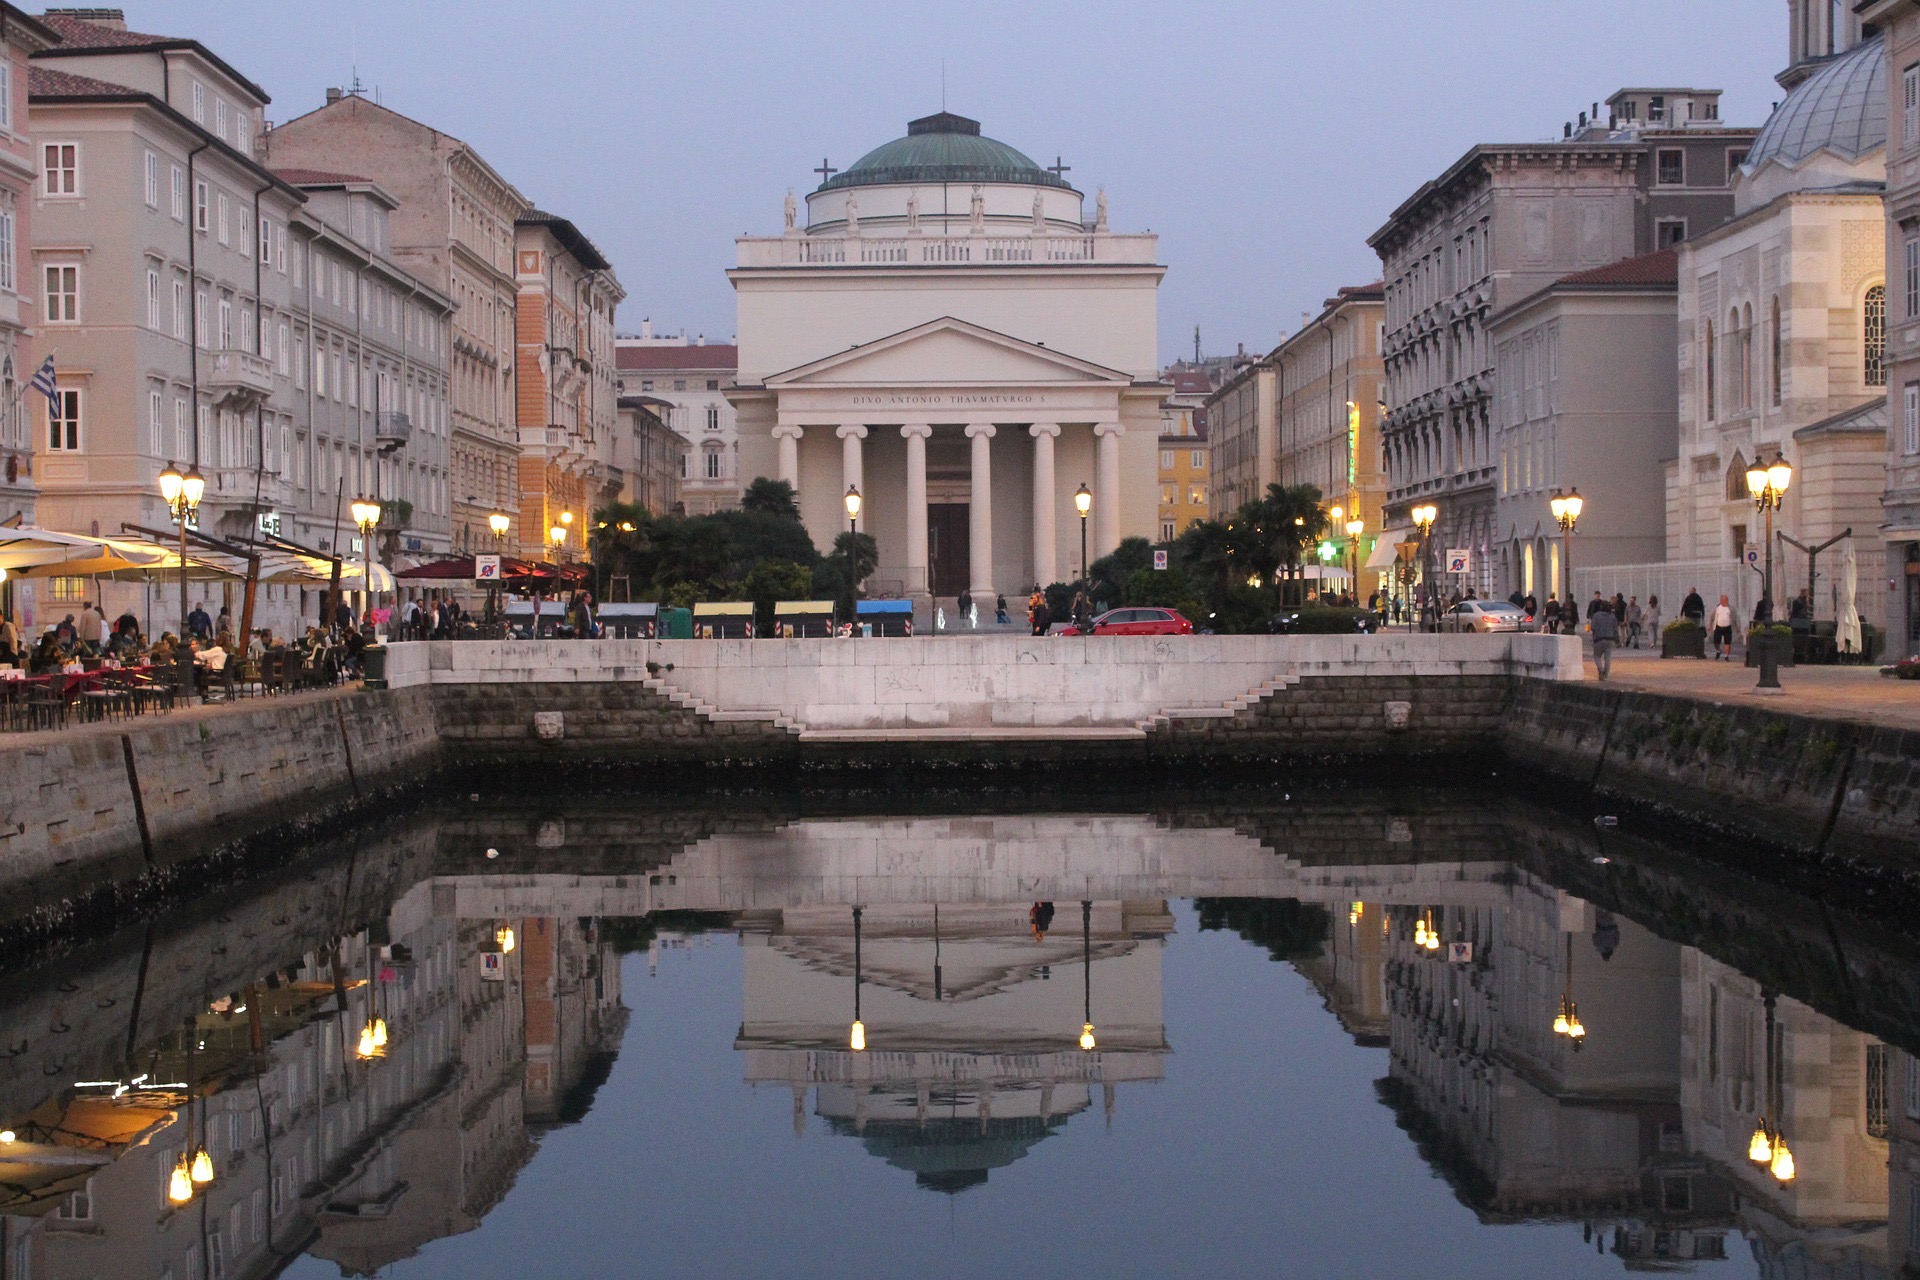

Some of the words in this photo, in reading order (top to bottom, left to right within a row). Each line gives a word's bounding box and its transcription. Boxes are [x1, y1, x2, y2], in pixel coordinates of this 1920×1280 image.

[853, 396, 882, 404] DIVO
[890, 396, 941, 404] ANTONIO
[950, 395, 1032, 404] THAVMATVRGO
